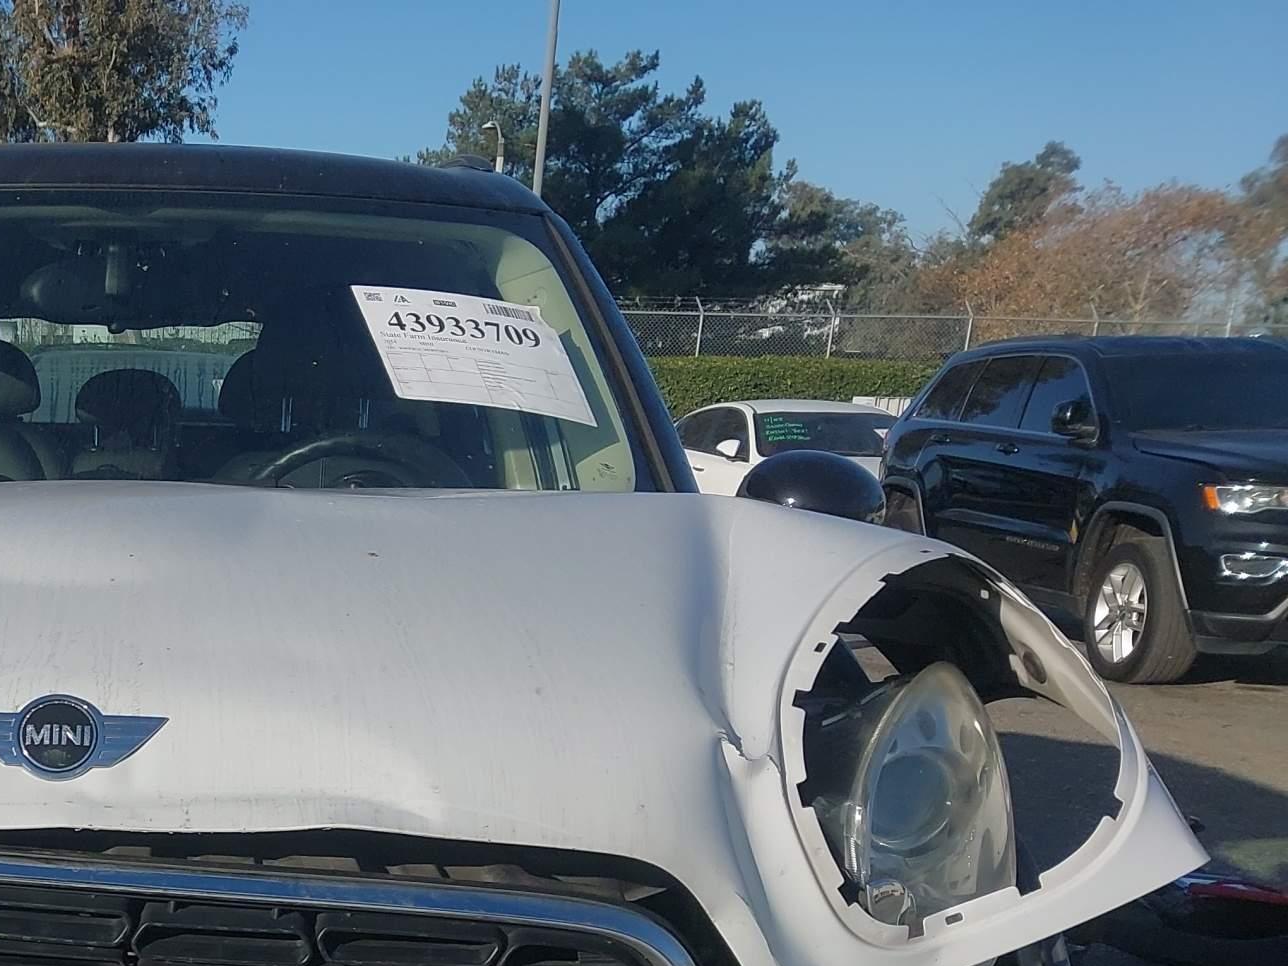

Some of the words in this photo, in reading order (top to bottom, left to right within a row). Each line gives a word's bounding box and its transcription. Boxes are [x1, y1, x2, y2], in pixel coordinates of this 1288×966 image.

[387, 311, 541, 348] 43933709
[403, 332, 426, 340] Farm
[25, 723, 92, 747] MINI
